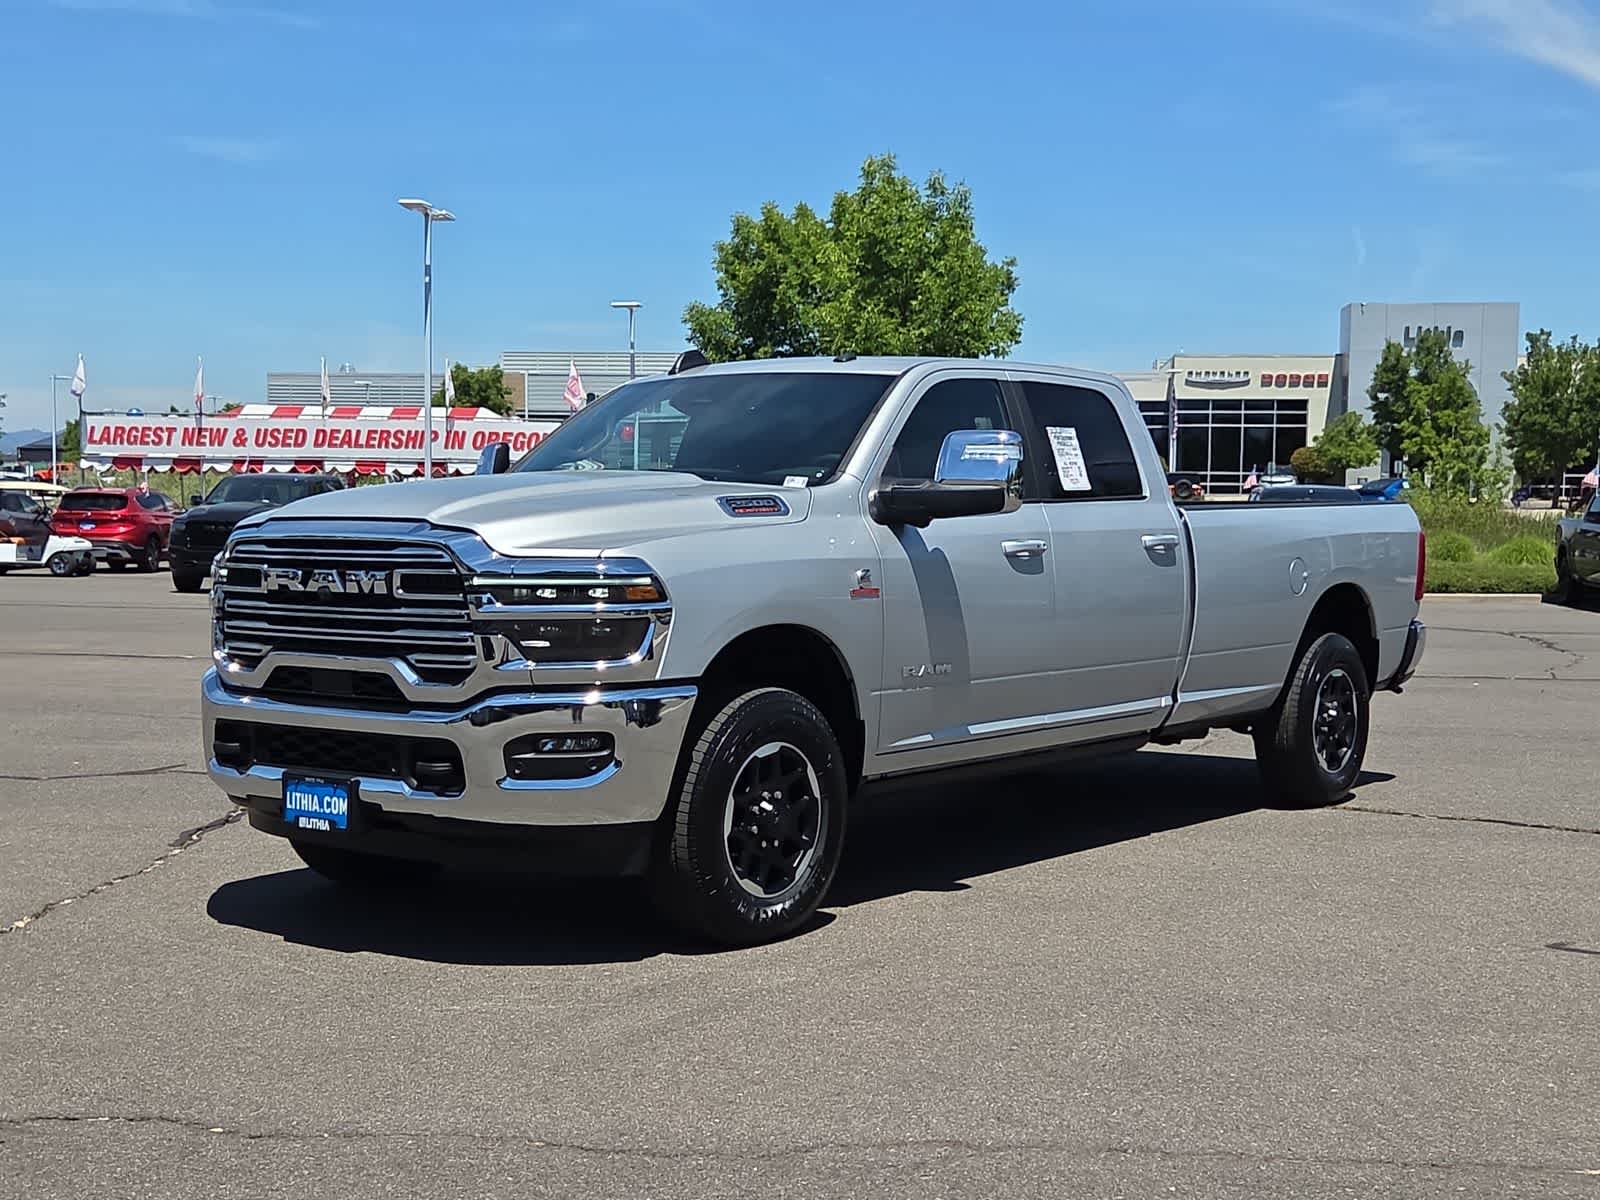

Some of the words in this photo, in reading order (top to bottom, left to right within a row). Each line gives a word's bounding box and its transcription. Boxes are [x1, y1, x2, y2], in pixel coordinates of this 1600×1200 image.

[87, 425, 177, 446] LARGEST
[181, 427, 228, 447] NEW
[232, 428, 249, 448] &
[254, 428, 308, 448] USED
[313, 429, 439, 450] DEALERSHIP
[444, 430, 466, 450] IN
[472, 431, 549, 452] OREGO
[265, 568, 389, 594] RAM
[902, 663, 952, 677] RAM
[286, 791, 348, 816] LITHIA.COM
